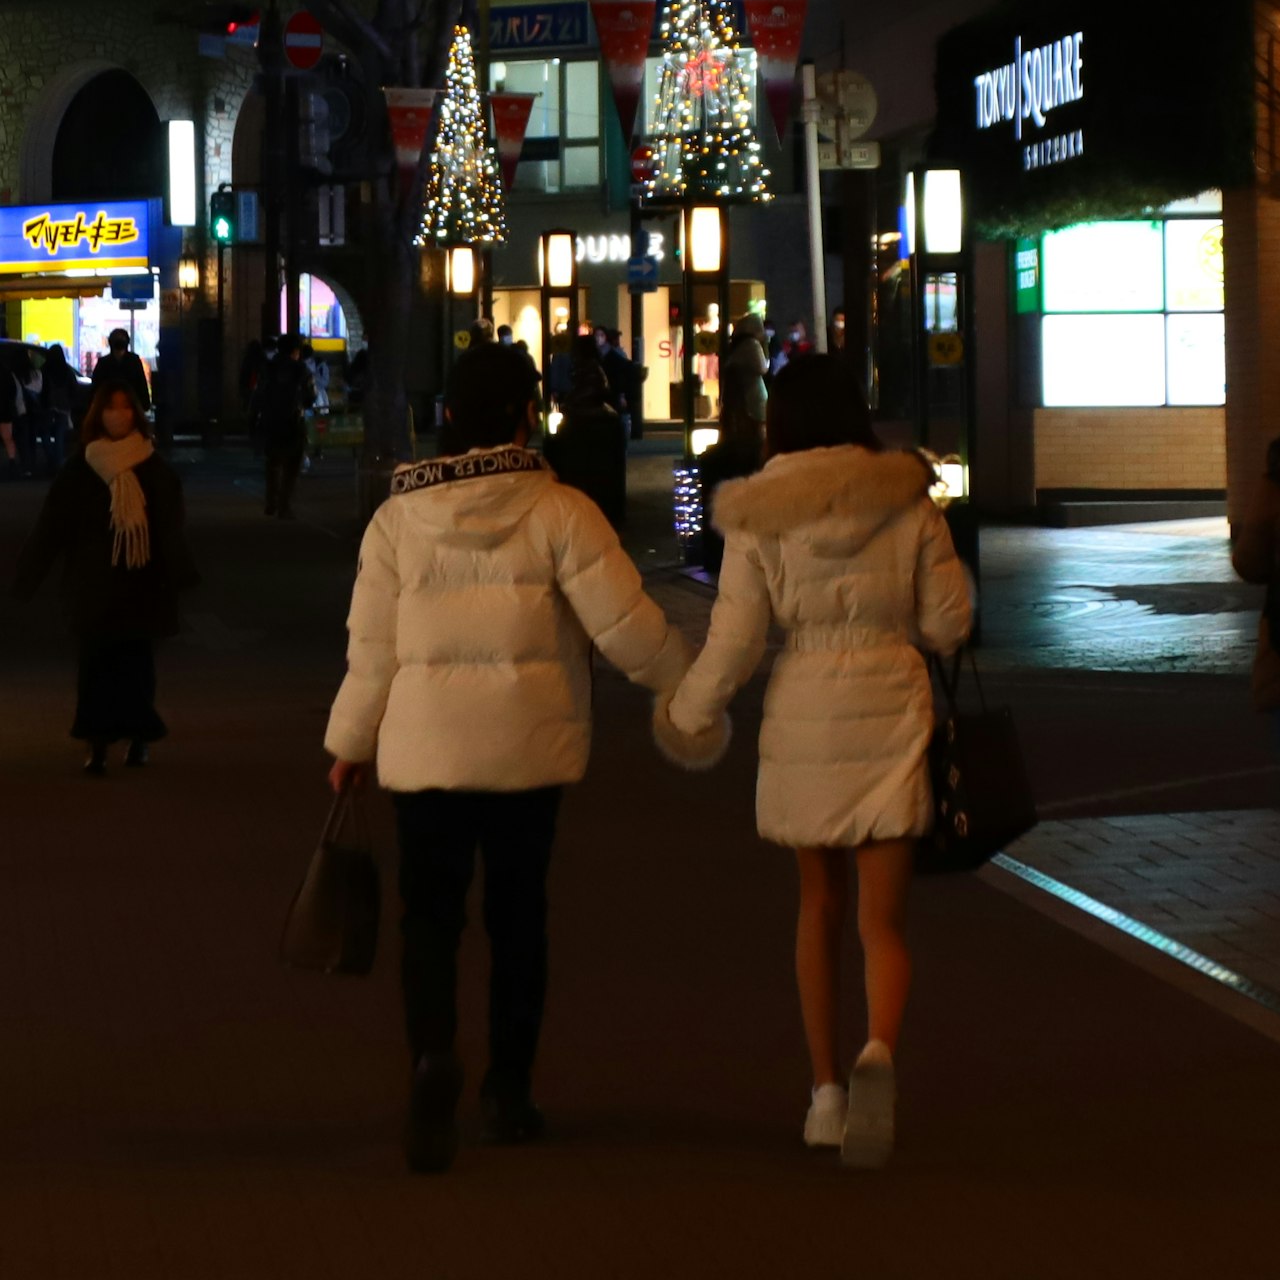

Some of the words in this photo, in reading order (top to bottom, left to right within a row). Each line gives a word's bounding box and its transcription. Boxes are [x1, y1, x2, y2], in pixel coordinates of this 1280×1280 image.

[974, 62, 1016, 129] TOKYU
[1022, 31, 1083, 128] SQUARE
[1023, 129, 1083, 171] SHIZUOKA
[24, 214, 137, 252] マツモトキヨシ
